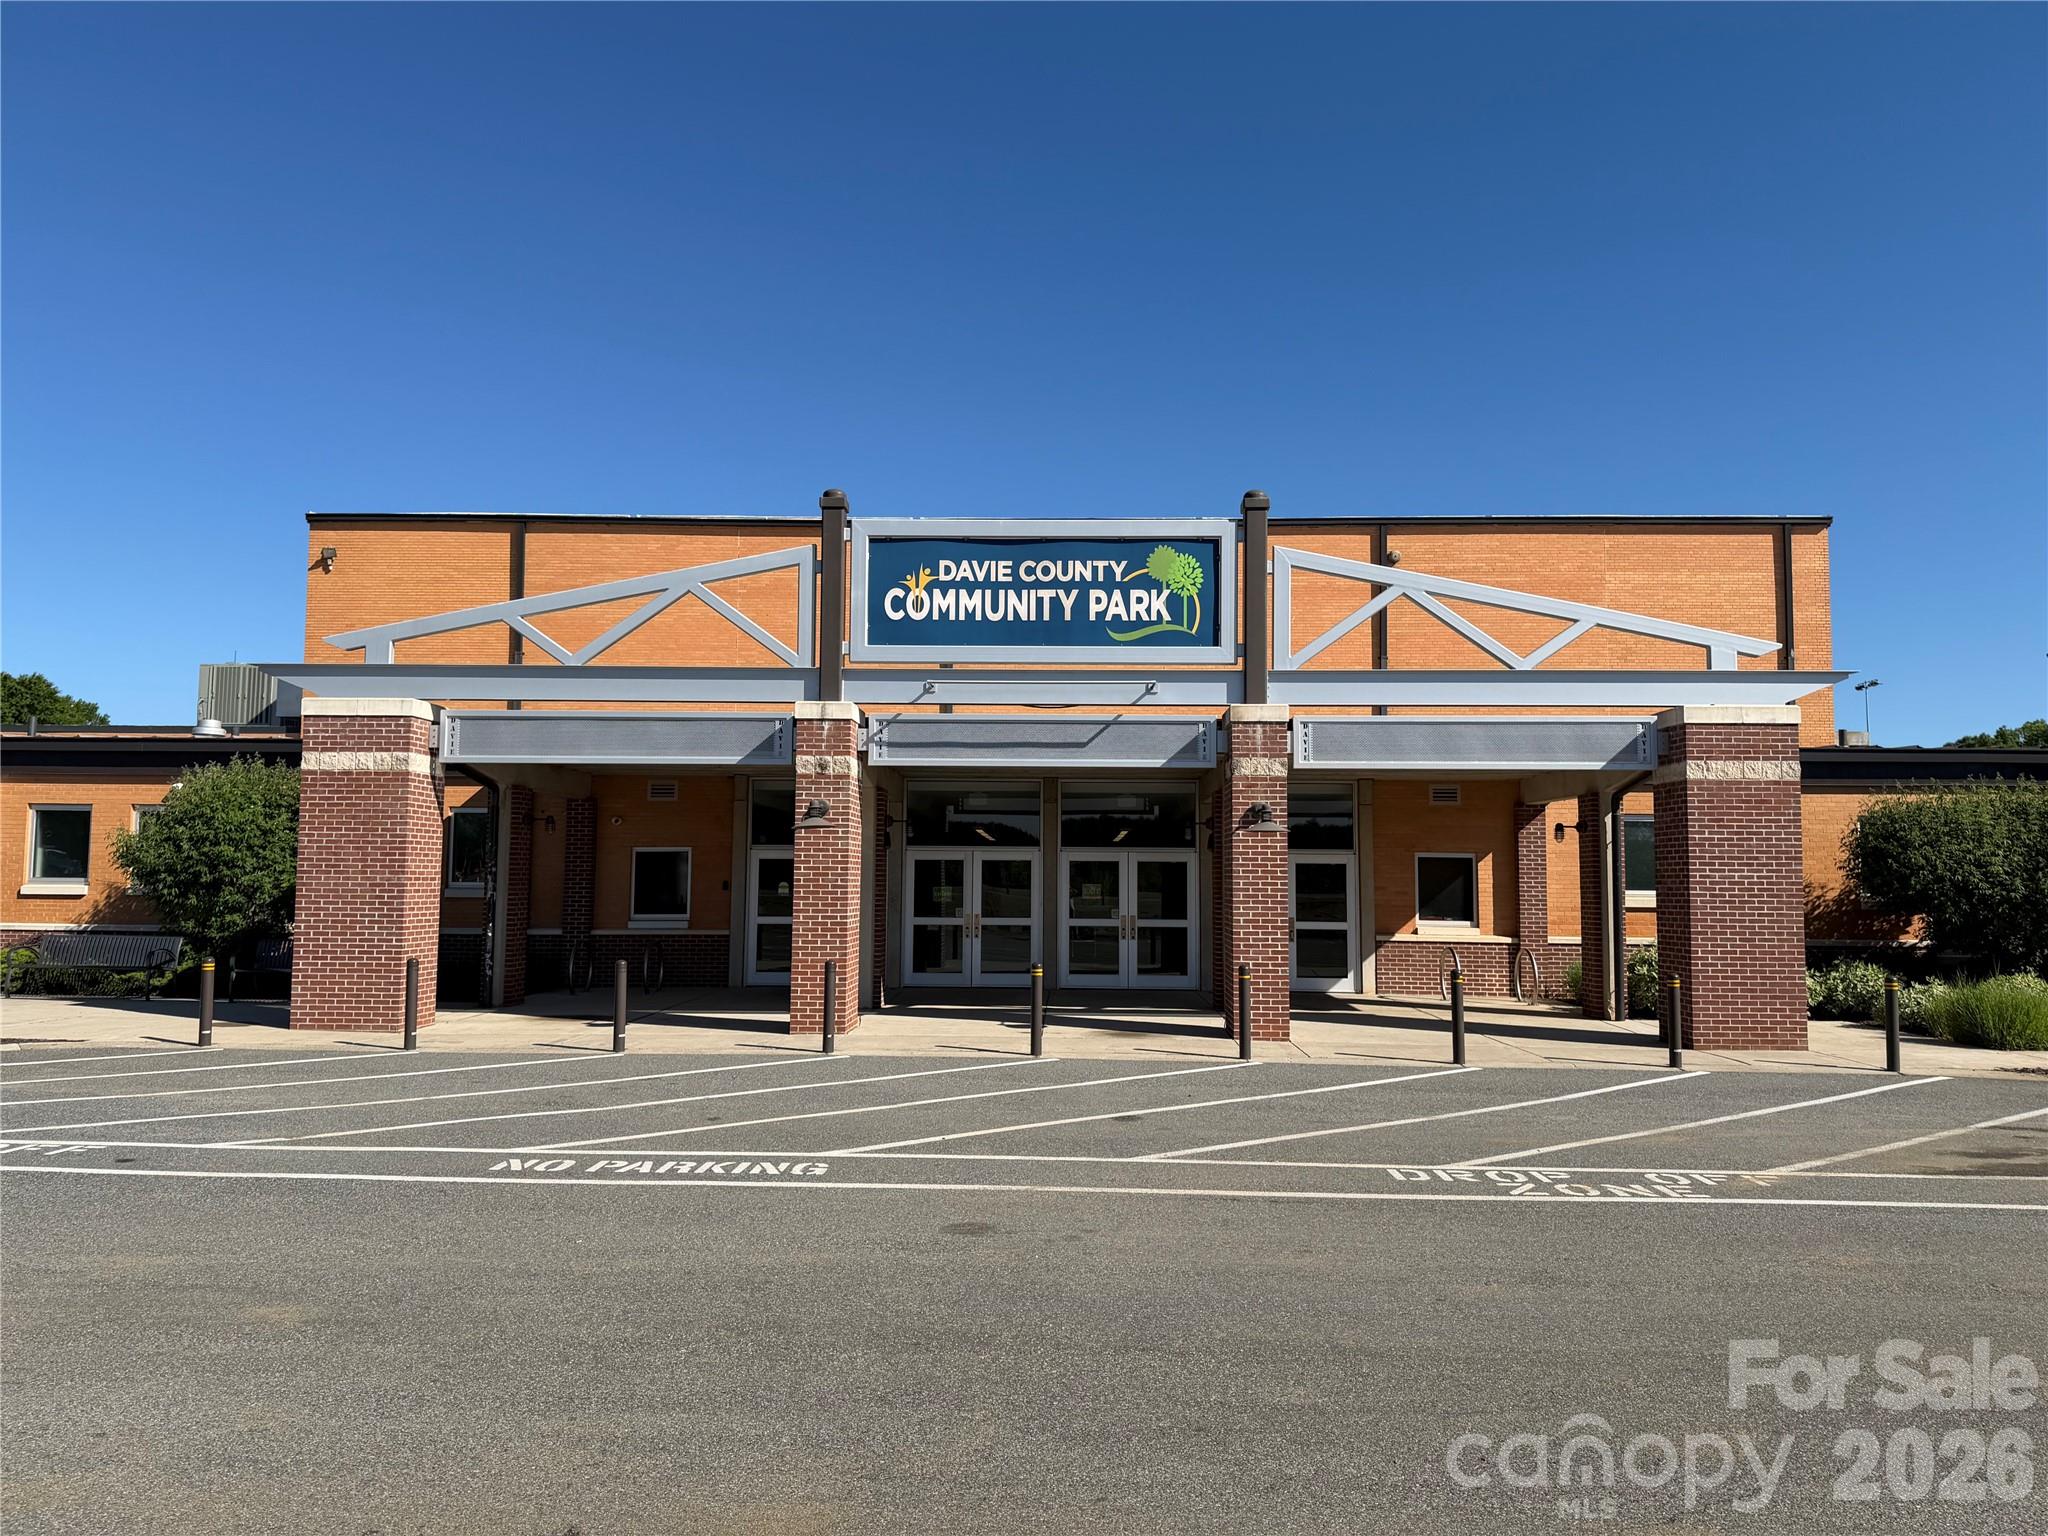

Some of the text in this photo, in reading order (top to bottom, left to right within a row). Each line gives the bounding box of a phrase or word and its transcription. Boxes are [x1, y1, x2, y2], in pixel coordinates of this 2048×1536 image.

[938, 559, 1128, 582] DAVIE COUNTY
[884, 588, 1172, 622] COMMUNITY PARK
[0, 1143, 107, 1155] FF
[488, 1158, 830, 1176] NO PARKING
[1386, 1168, 1780, 1186] DROP OFF
[1496, 1182, 1711, 1198] ZONE
